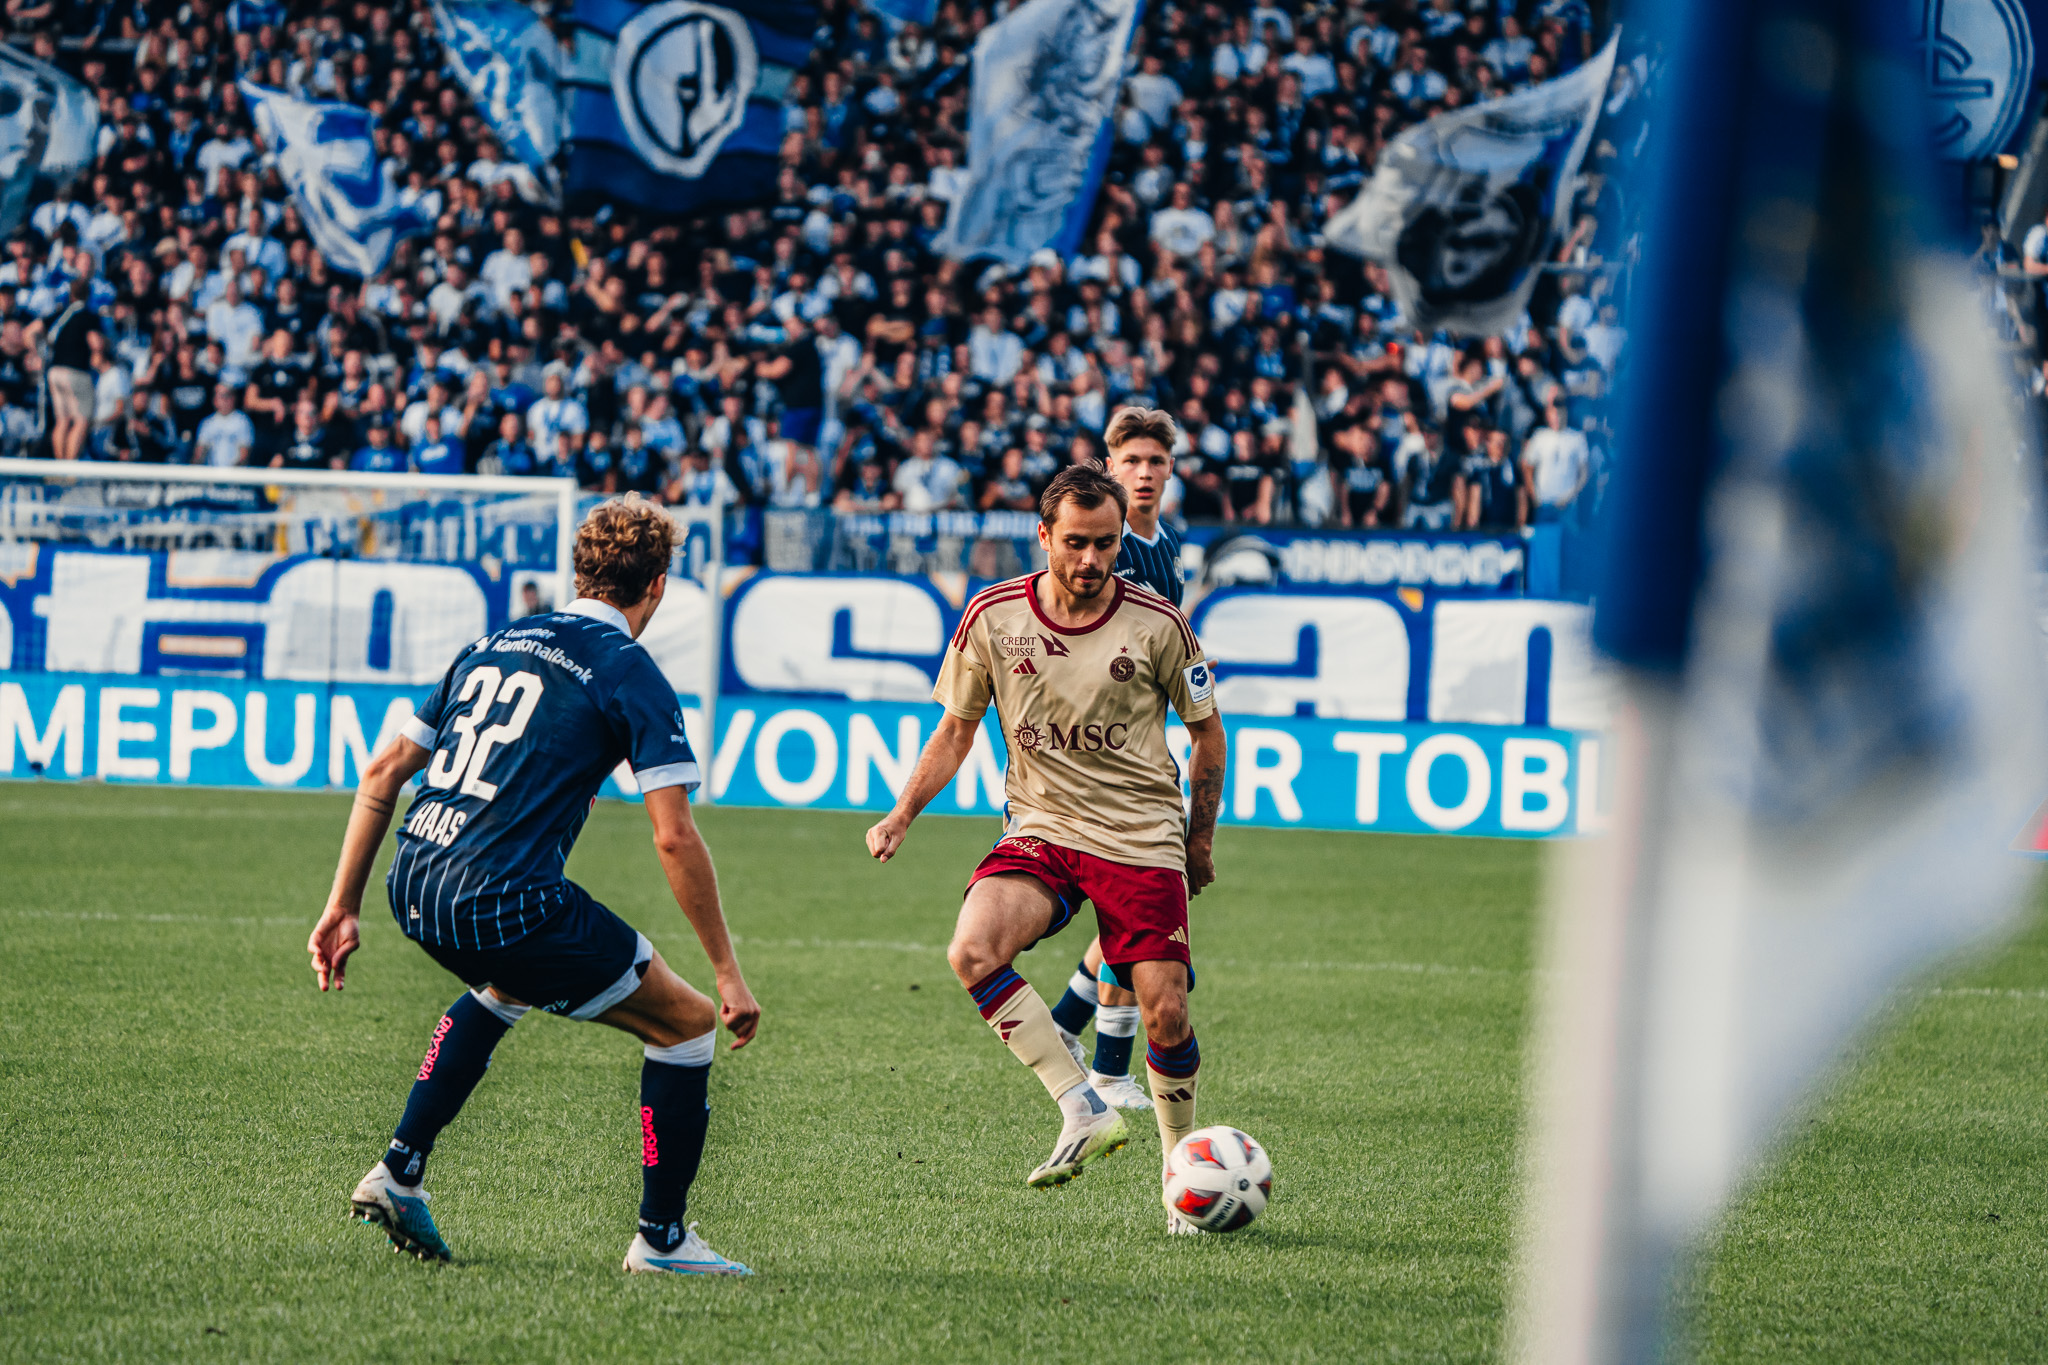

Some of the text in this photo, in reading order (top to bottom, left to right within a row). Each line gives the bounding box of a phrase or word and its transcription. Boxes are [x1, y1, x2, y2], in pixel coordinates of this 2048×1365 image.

[490, 638, 593, 685] Kantonalbank
[1001, 636, 1037, 646] CREDIT
[1006, 647, 1036, 657] SUISSE
[0, 682, 642, 797] MEPUM
[427, 665, 545, 802] 32
[1047, 722, 1128, 752] MSC
[406, 801, 468, 848] HAAS
[416, 1016, 454, 1081] VERSAND
